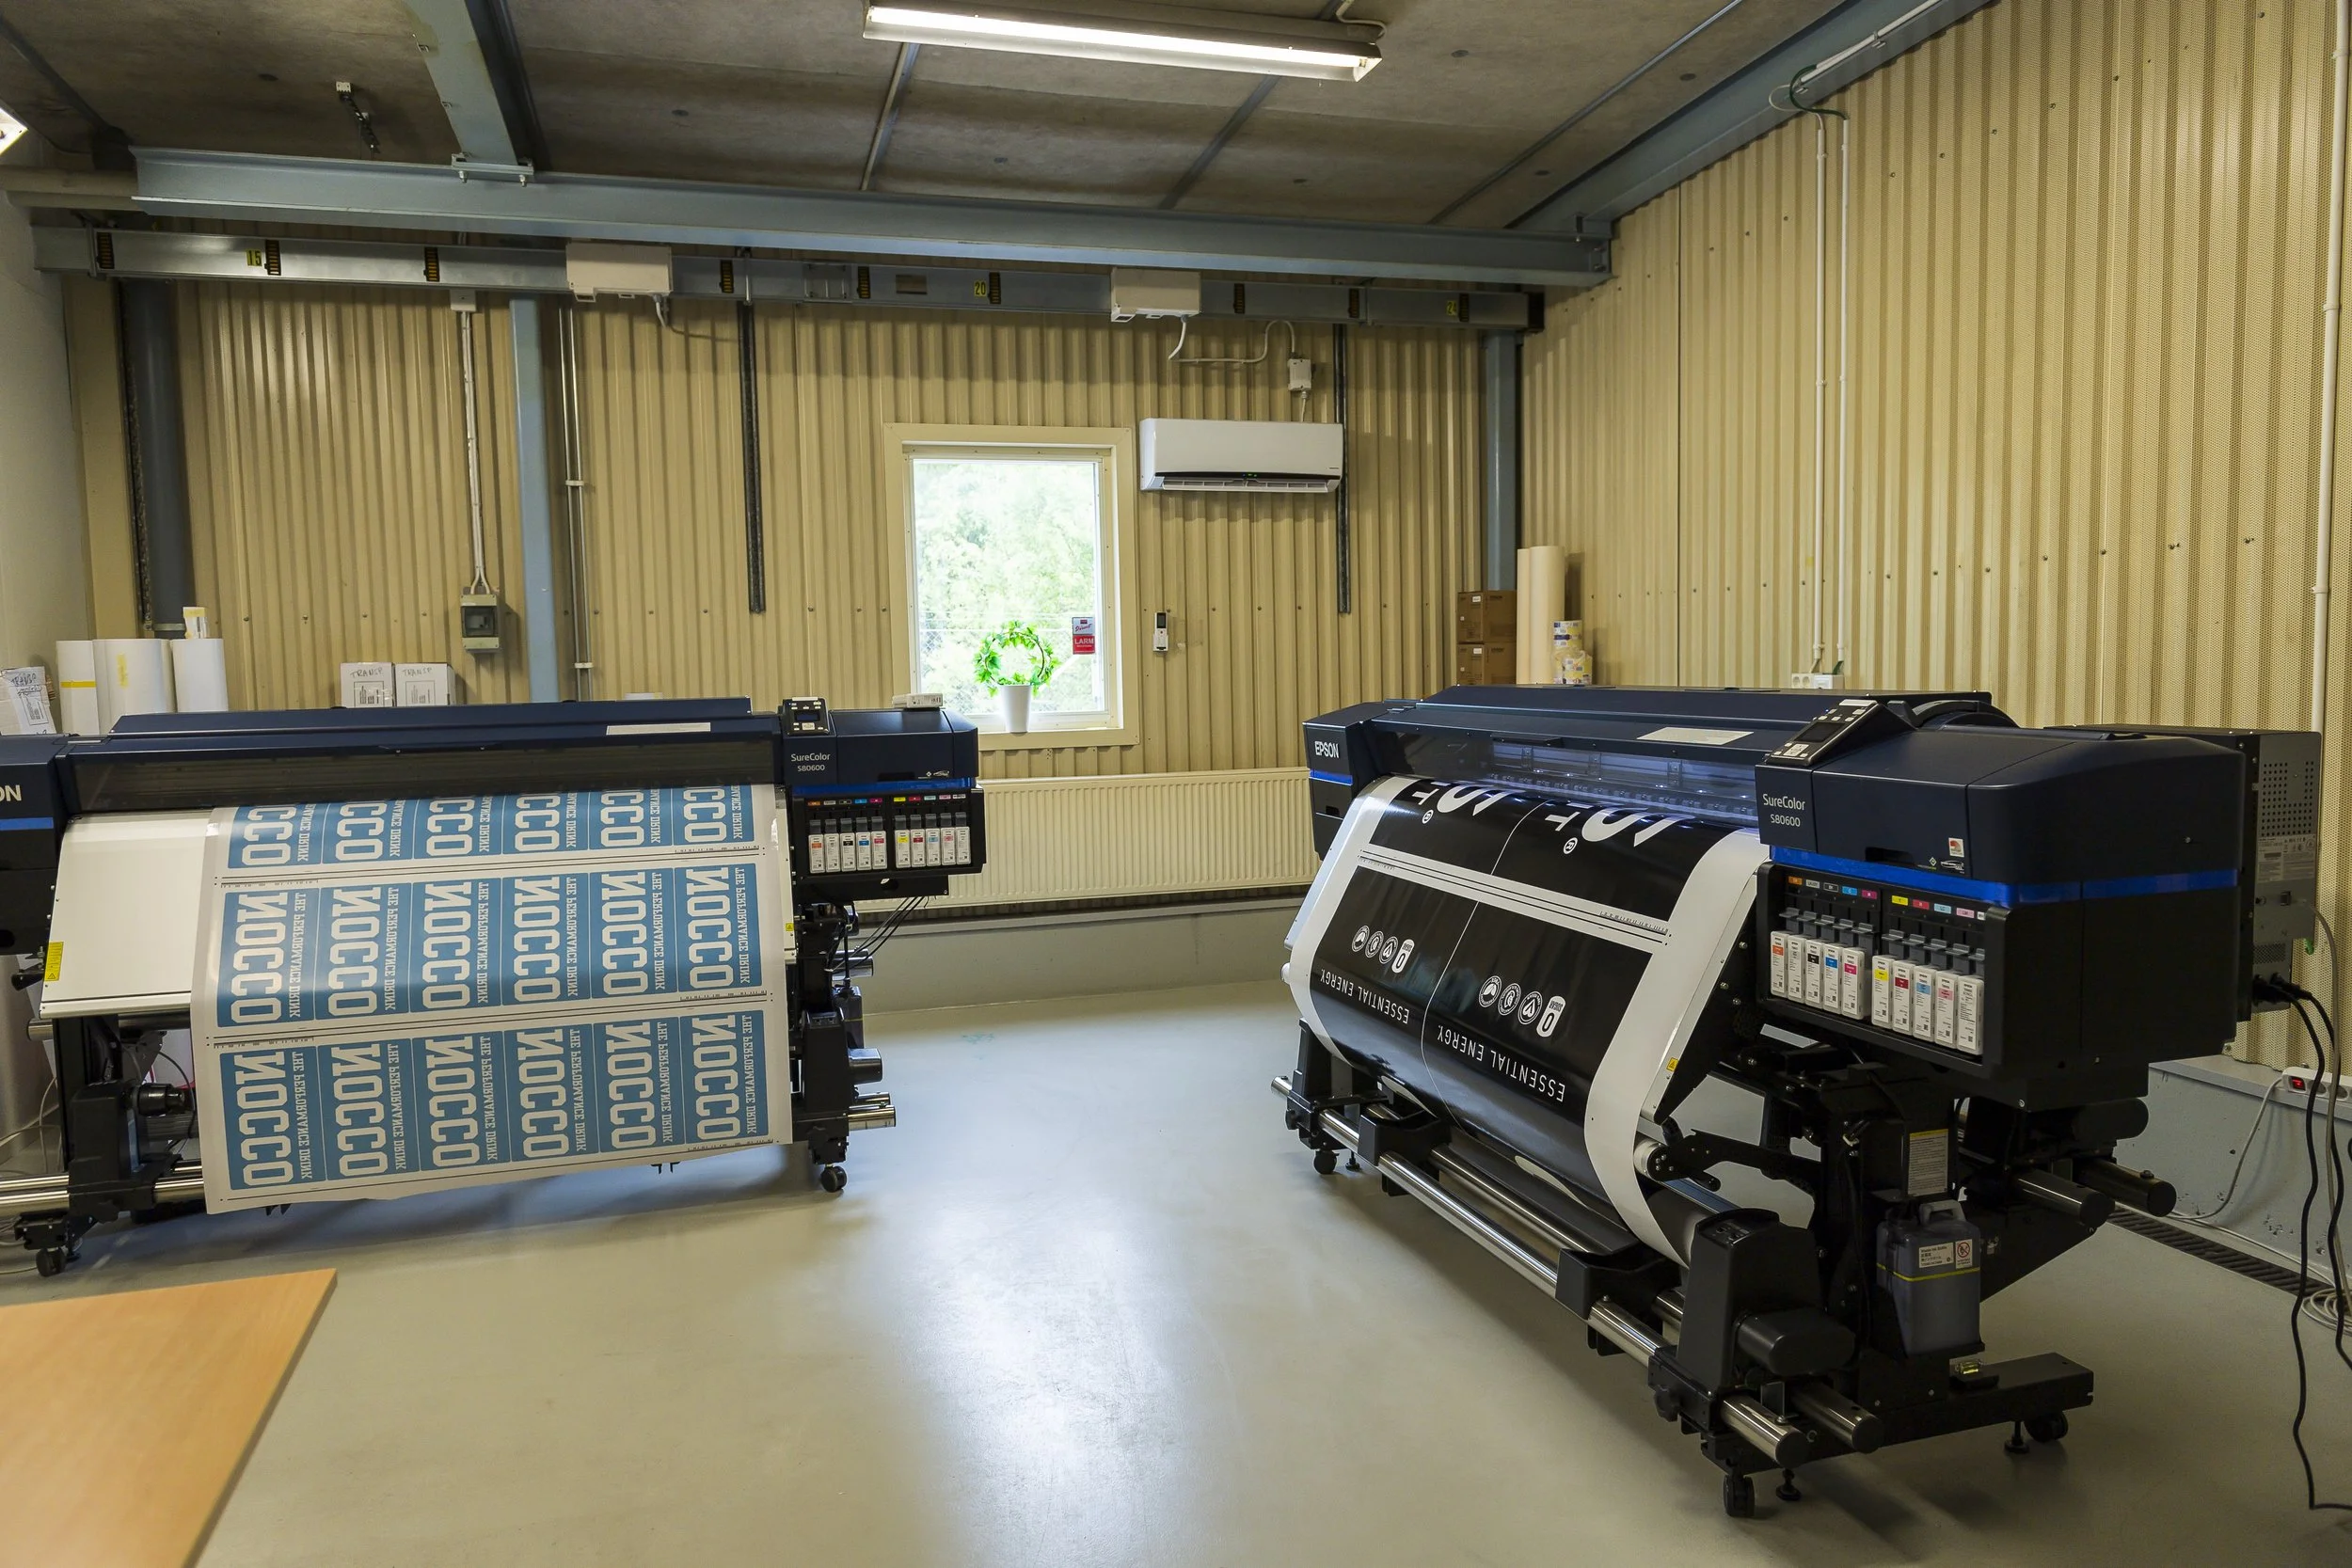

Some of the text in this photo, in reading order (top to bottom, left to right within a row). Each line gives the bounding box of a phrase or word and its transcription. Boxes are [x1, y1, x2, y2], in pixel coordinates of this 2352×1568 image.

[247, 250, 262, 266] 15
[975, 281, 986, 295] 20
[790, 752, 831, 762] SureColor
[1314, 740, 1340, 759] EPSON
[797, 764, 826, 772] S80600
[1762, 793, 1806, 812] SureColor
[1770, 813, 1802, 828] S80600
[1357, 985, 1410, 1025] ESSENTIAL
[1542, 1012, 1554, 1033] 0
[1491, 1050, 1566, 1103] ESSENTIAL
